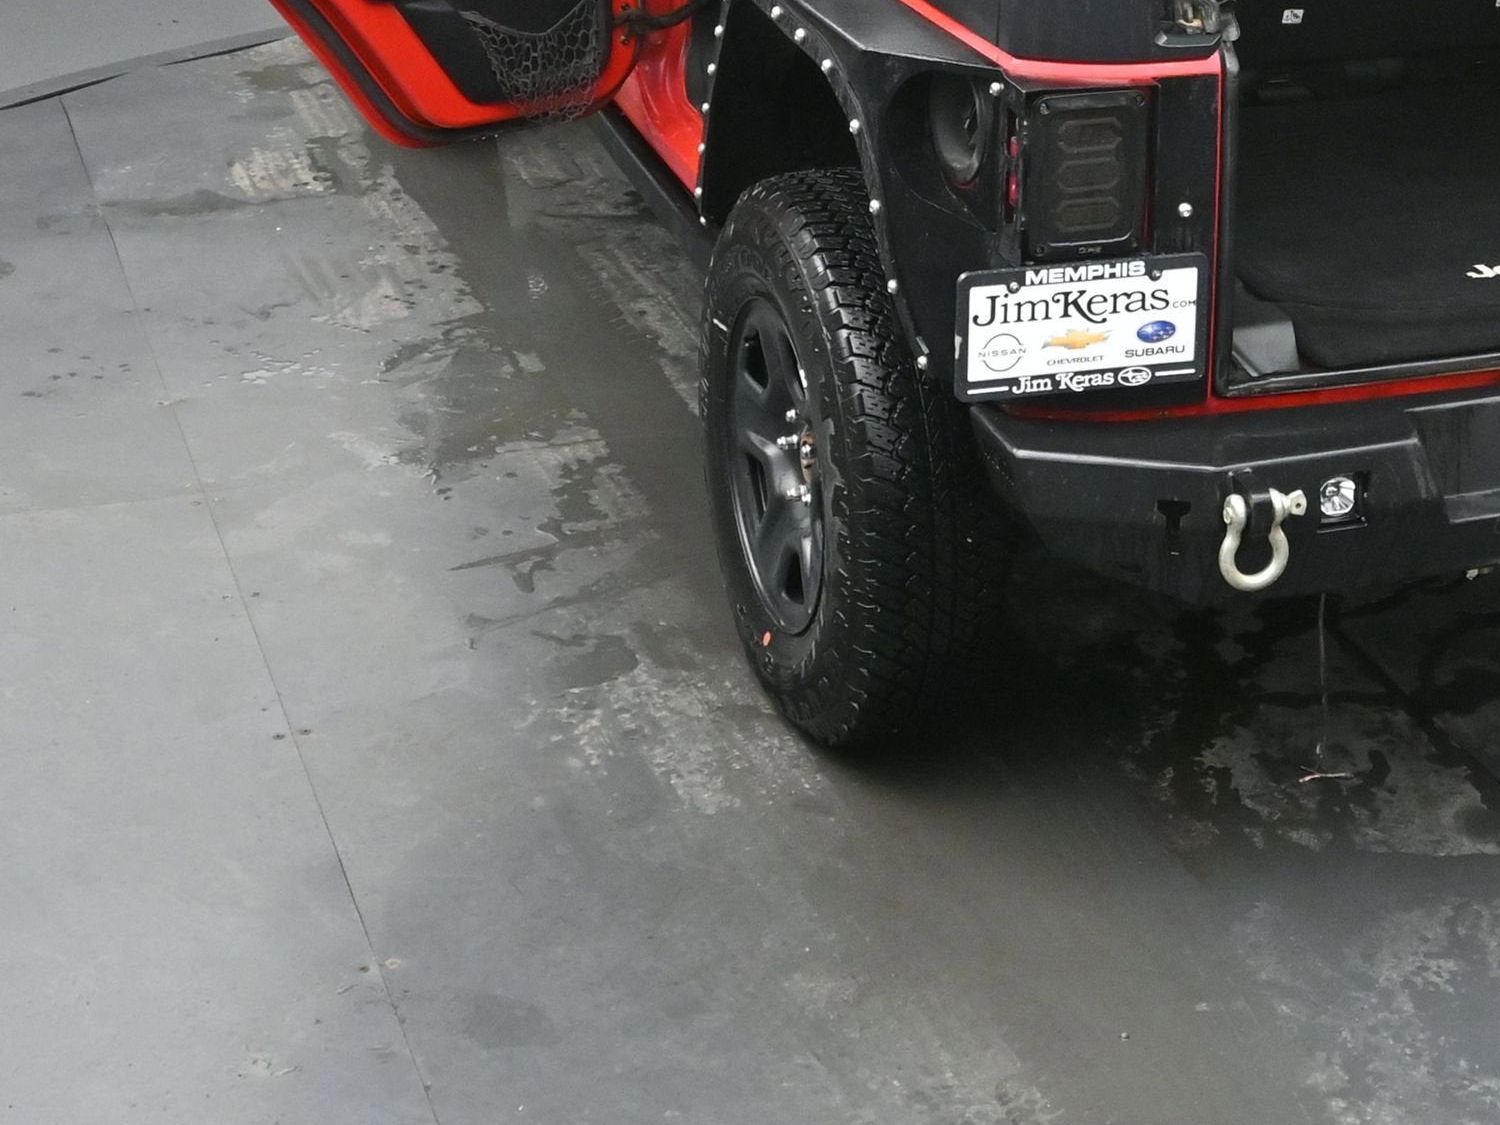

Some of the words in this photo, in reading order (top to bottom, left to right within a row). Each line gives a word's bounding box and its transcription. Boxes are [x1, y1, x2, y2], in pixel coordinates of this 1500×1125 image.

[1025, 261, 1145, 285] MEMPHIS
[978, 347, 1026, 358] NISSAN
[1125, 345, 1185, 358] SUBARU
[1047, 355, 1104, 366] CHEVROLET
[1012, 376, 1052, 394] Jim
[1055, 372, 1115, 391] Keras
